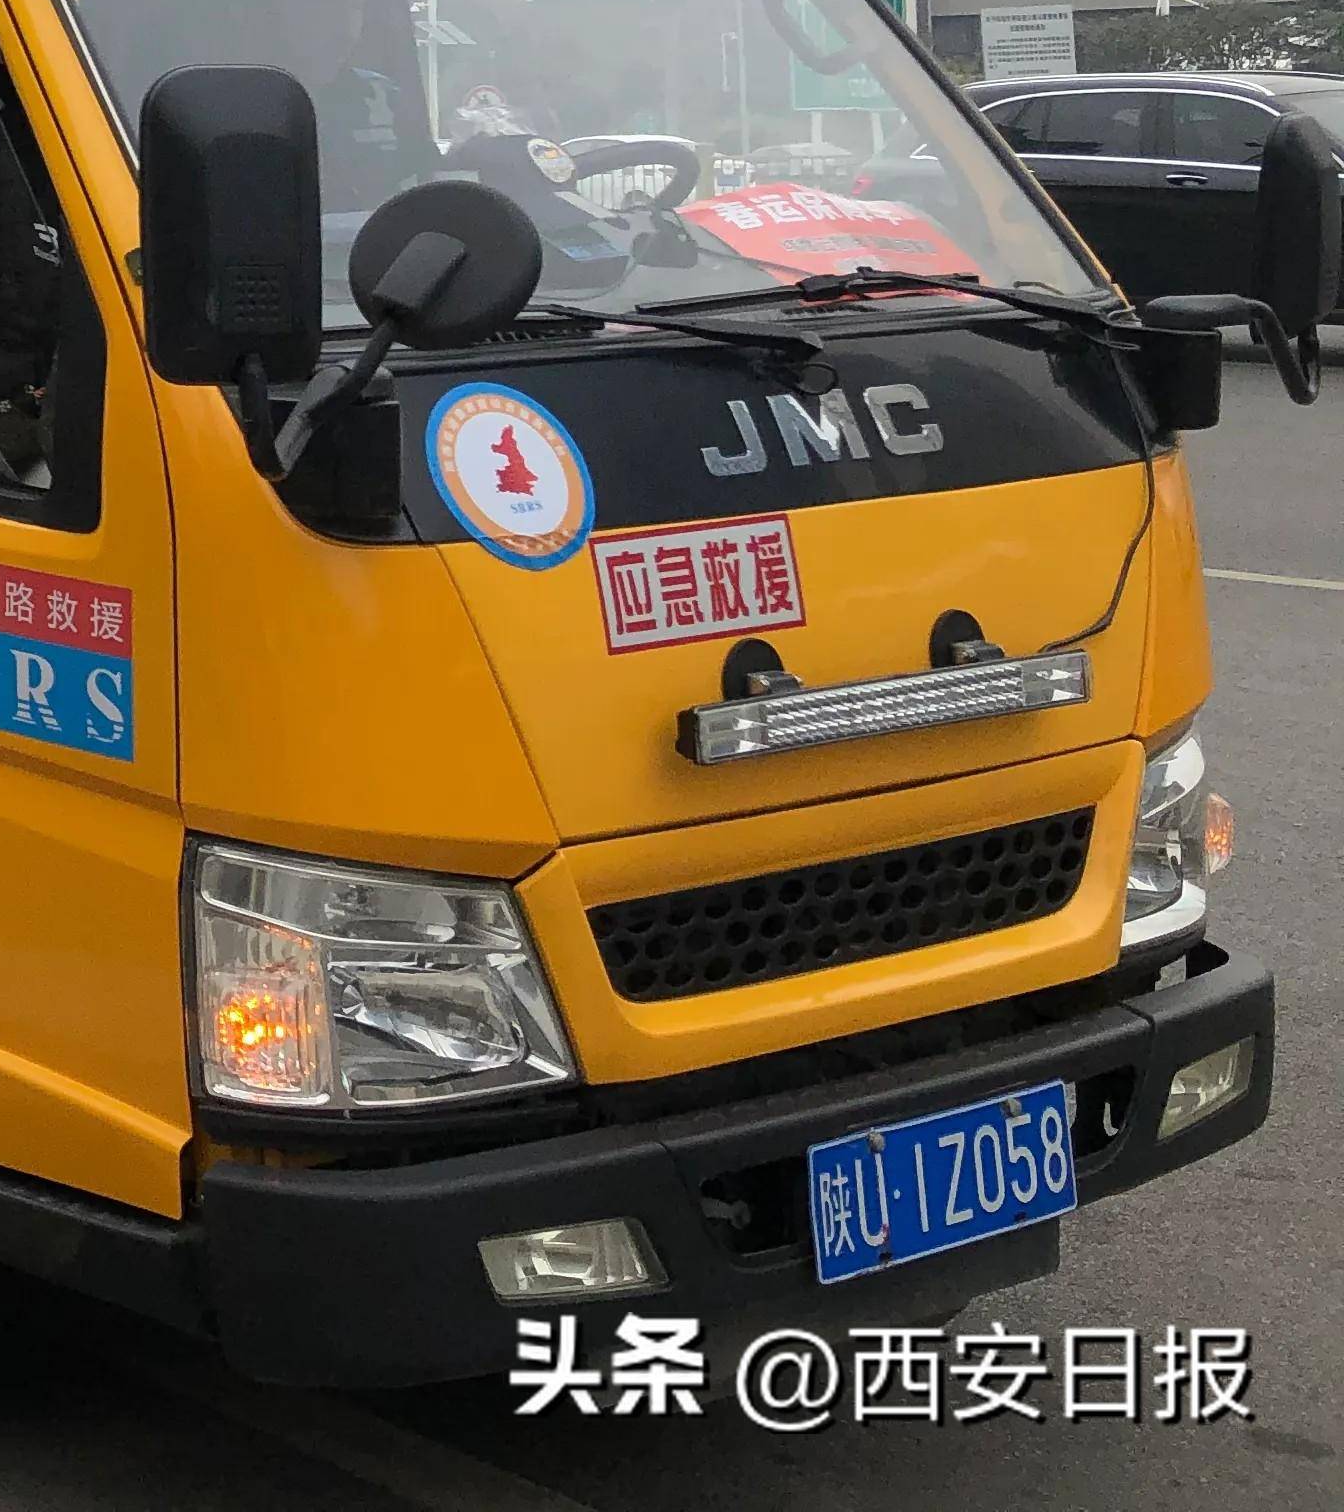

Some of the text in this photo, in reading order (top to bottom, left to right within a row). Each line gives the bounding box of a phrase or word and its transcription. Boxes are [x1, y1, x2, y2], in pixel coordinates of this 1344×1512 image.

[699, 383, 945, 478] JMC
[604, 530, 795, 636] 应急救援
